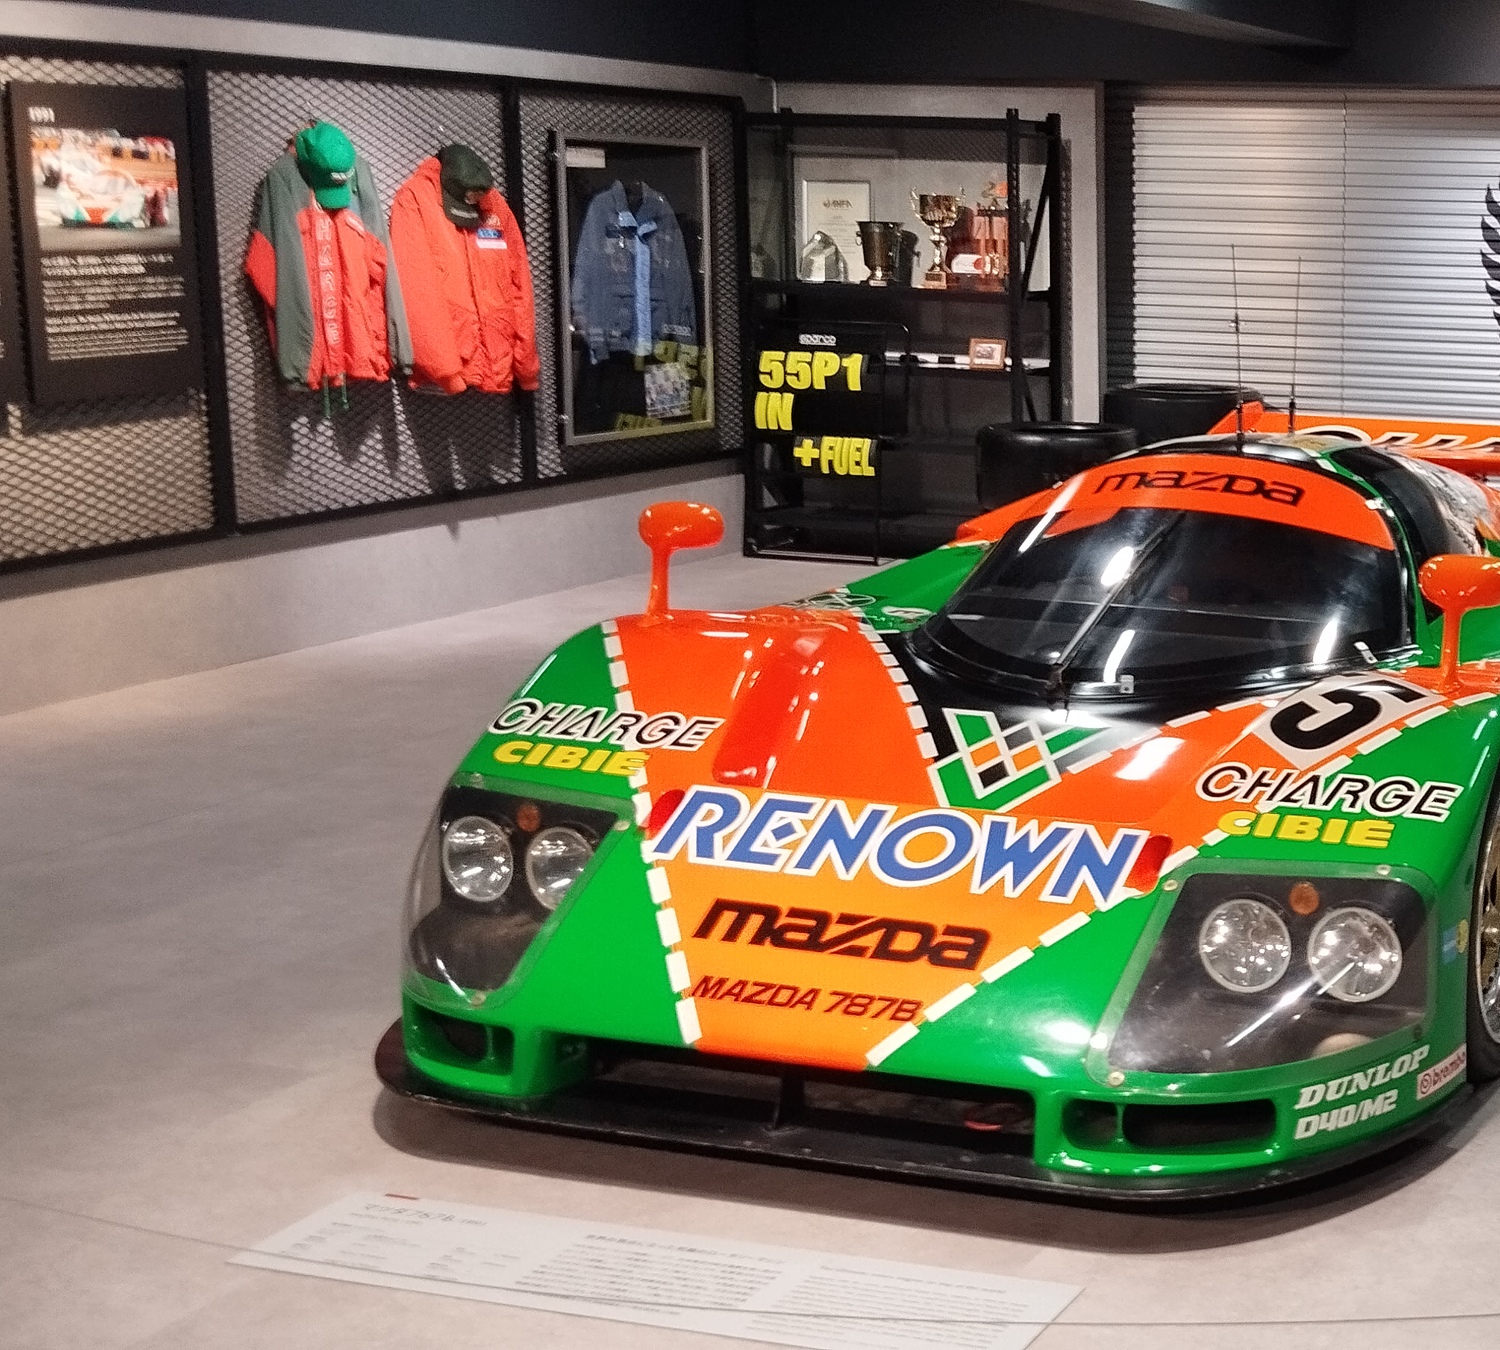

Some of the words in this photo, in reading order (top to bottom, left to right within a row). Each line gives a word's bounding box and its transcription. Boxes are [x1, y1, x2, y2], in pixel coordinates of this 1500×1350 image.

[758, 350, 863, 391] 55P1
[754, 391, 795, 431] IN
[1094, 470, 1306, 507] mazda
[489, 698, 726, 751] CHARGE
[1195, 761, 1464, 822] CHARGE
[651, 785, 1149, 911] RENOWN
[692, 898, 992, 970] mazda
[690, 975, 822, 1011] MAZDA
[824, 990, 924, 1022] 787B
[1294, 1044, 1430, 1110] DUNLOP
[1294, 1088, 1398, 1140] D40/M2
